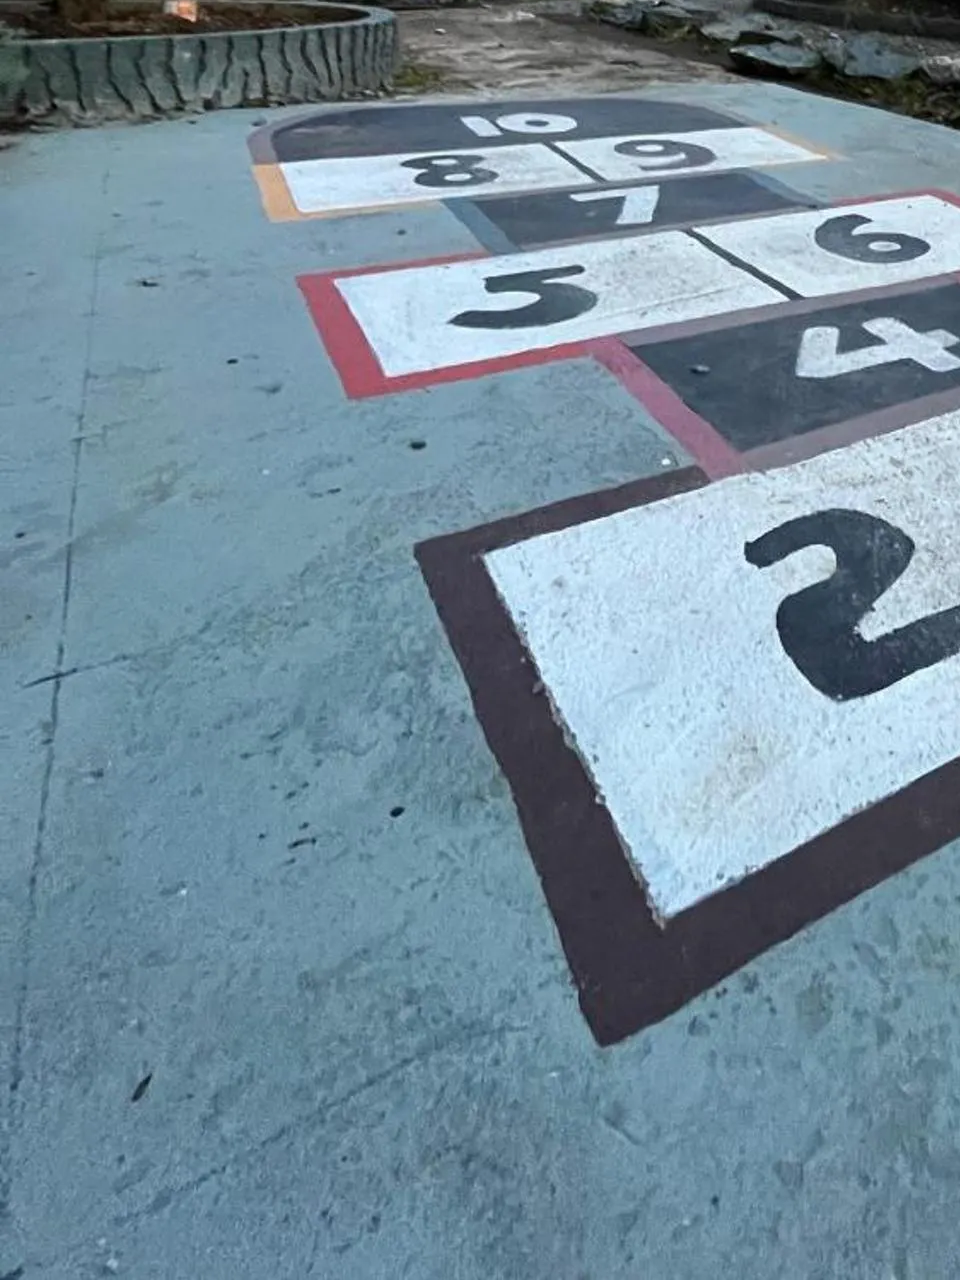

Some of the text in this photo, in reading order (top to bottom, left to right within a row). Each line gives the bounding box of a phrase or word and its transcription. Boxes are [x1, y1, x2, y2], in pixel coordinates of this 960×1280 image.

[460, 112, 578, 137] 10
[400, 154, 499, 187] 8
[614, 139, 716, 171] 9
[570, 185, 660, 223] 7
[814, 213, 931, 263] 6
[447, 264, 598, 329] 5
